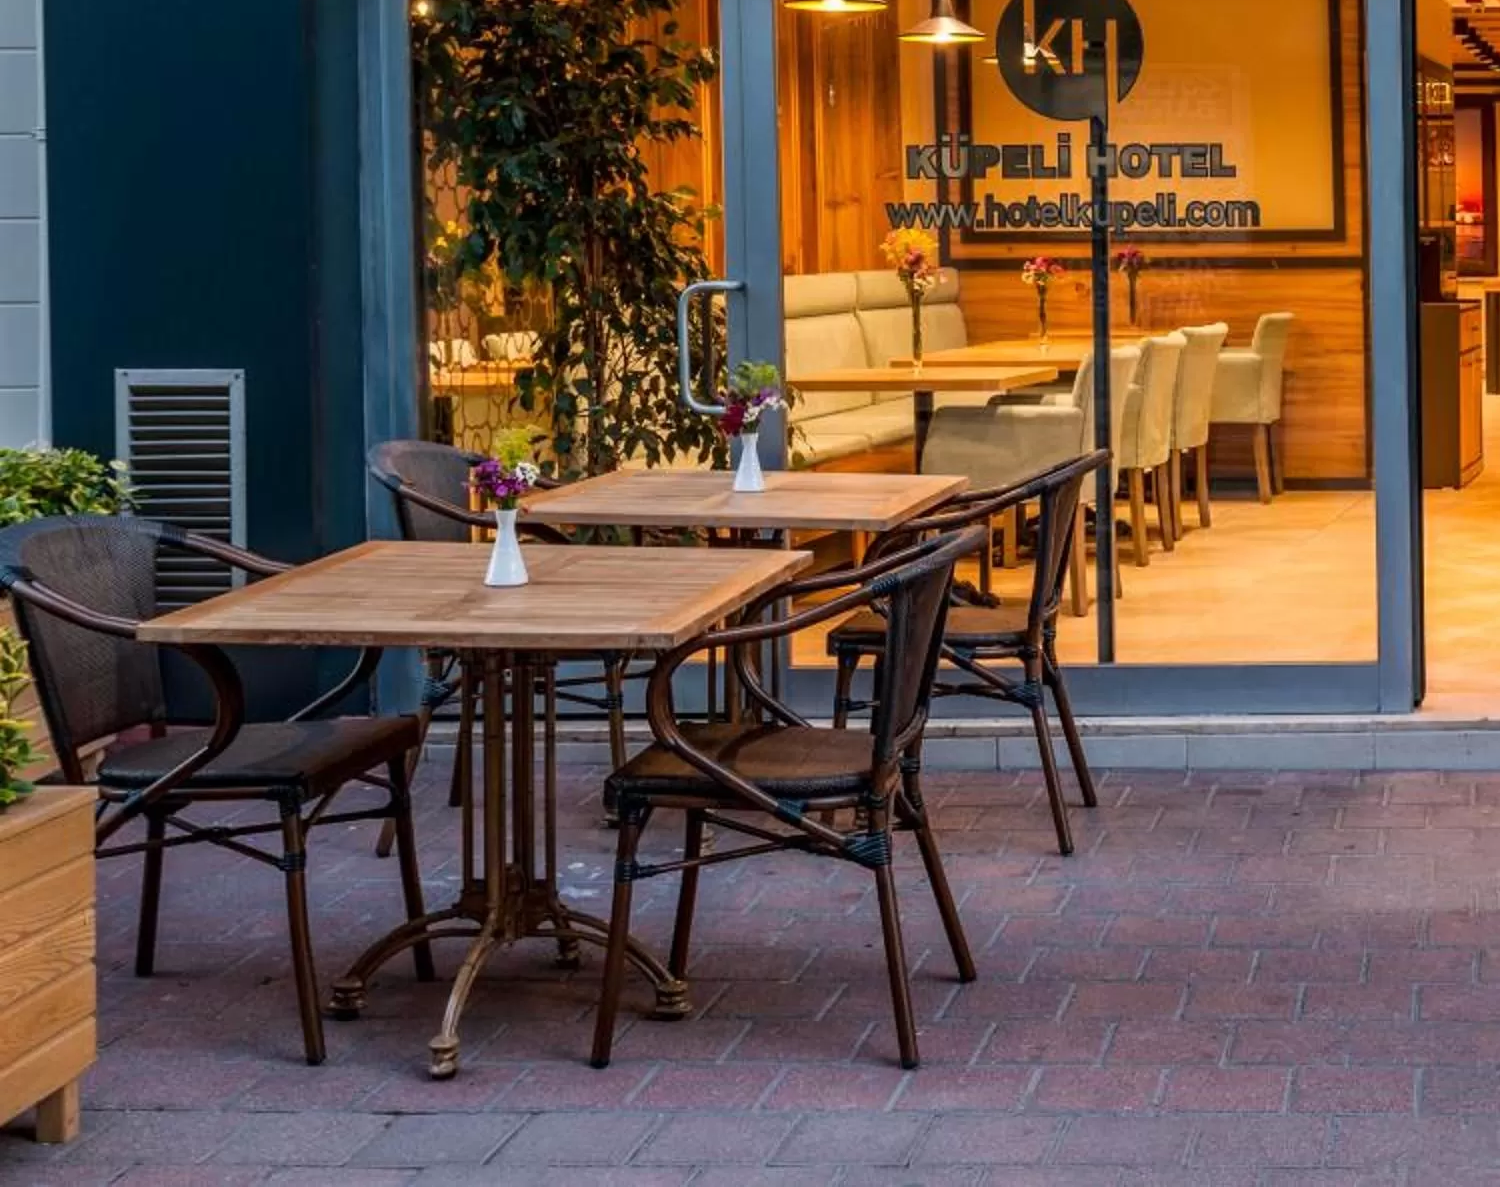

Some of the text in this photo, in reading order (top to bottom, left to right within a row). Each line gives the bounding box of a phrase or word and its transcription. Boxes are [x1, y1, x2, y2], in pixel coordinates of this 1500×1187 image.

[905, 133, 1237, 180] KÜPELİ HOTEL
[886, 193, 1262, 236] www.hotelkupeli.com
